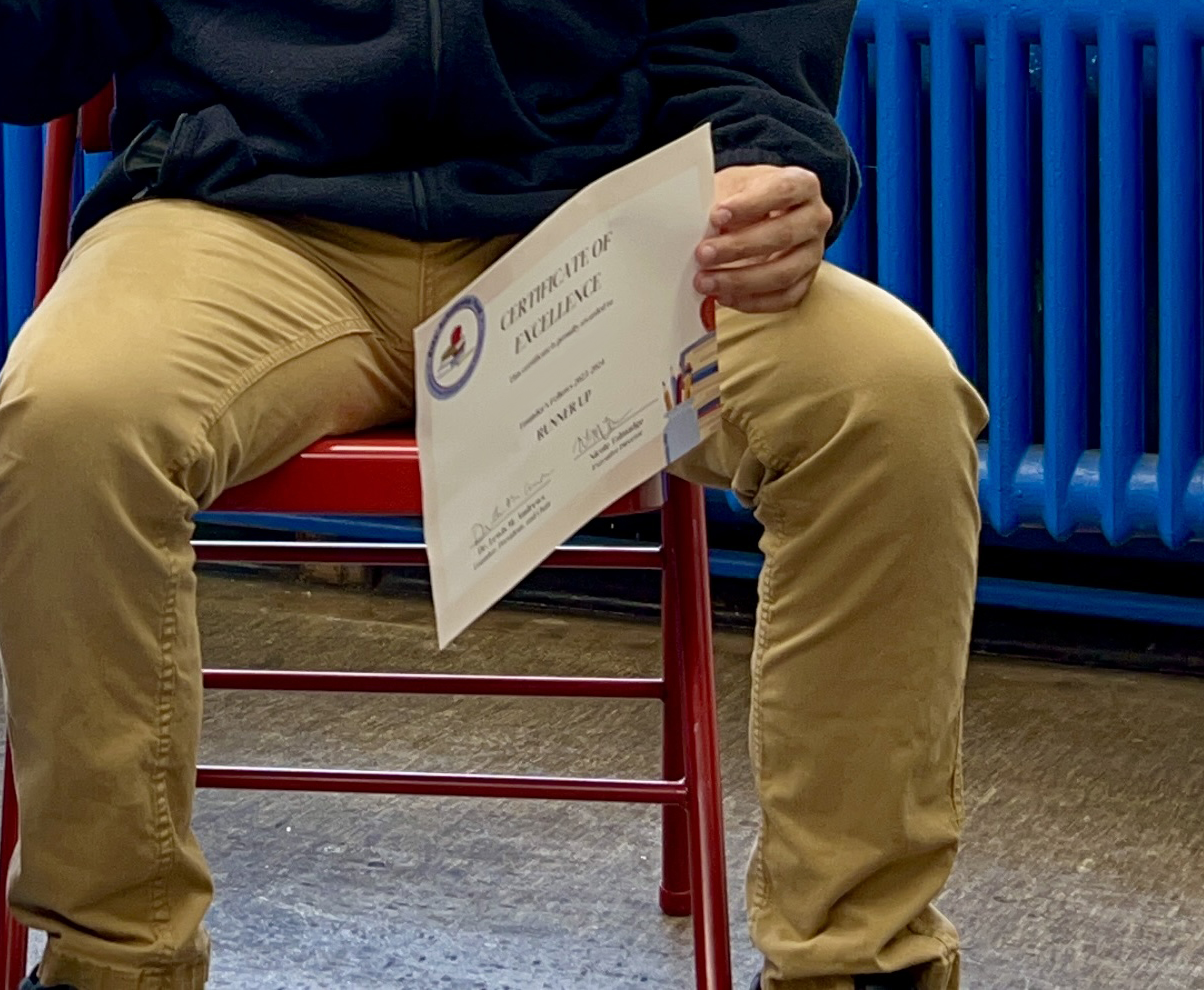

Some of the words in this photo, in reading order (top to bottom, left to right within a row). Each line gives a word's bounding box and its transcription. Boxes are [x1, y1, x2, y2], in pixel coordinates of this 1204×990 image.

[500, 246, 591, 331] CERTIFICATE
[591, 230, 614, 259] OF
[514, 271, 602, 355] EXCELLENCE
[536, 401, 577, 442] RUNNER
[578, 389, 592, 408] UP
